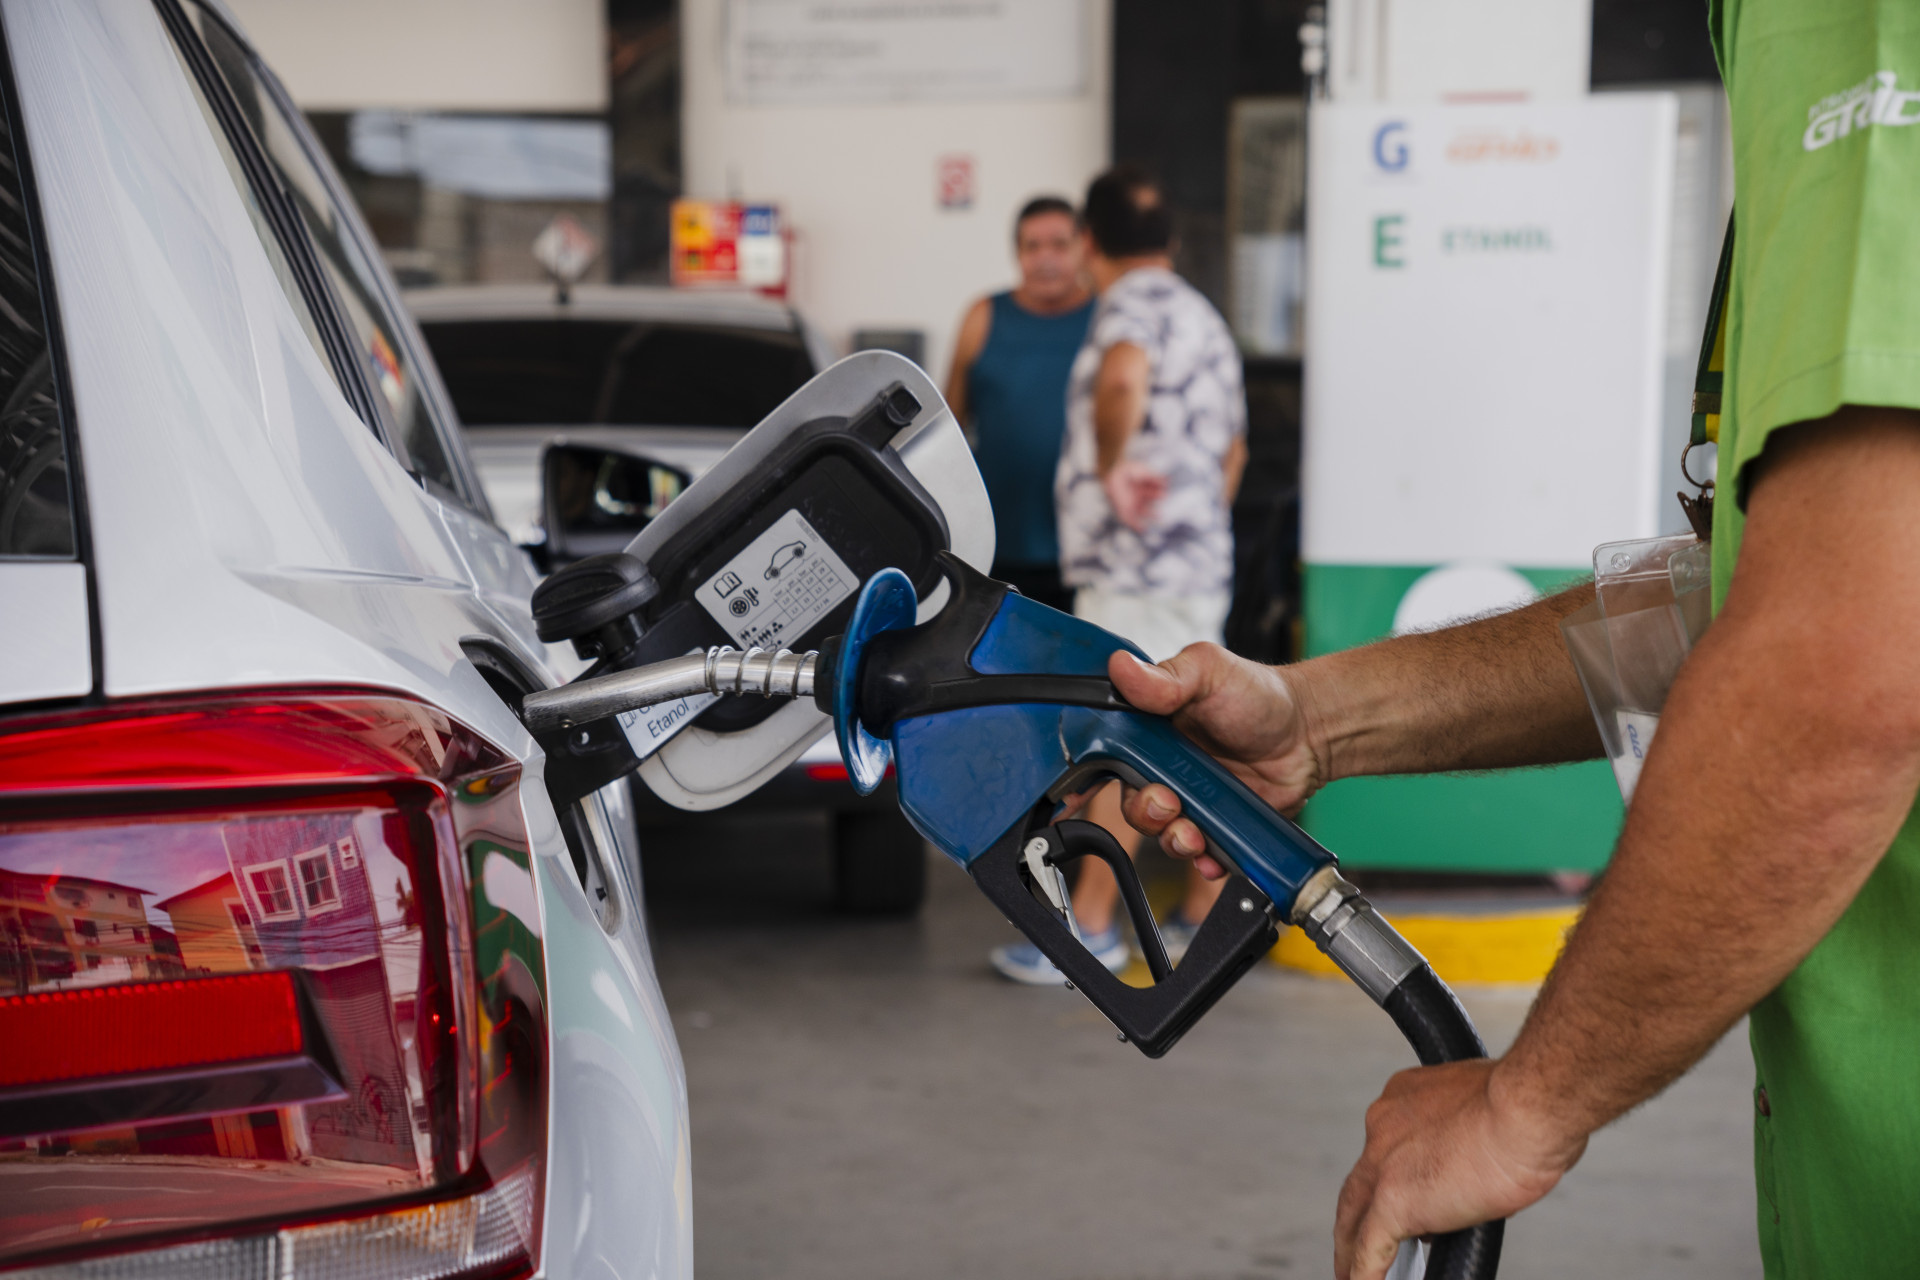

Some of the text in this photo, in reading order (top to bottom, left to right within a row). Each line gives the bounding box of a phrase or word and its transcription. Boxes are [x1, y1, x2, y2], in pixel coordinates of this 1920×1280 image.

[1373, 119, 1410, 172] G
[1373, 215, 1406, 269] E
[647, 698, 690, 739] Etanol
